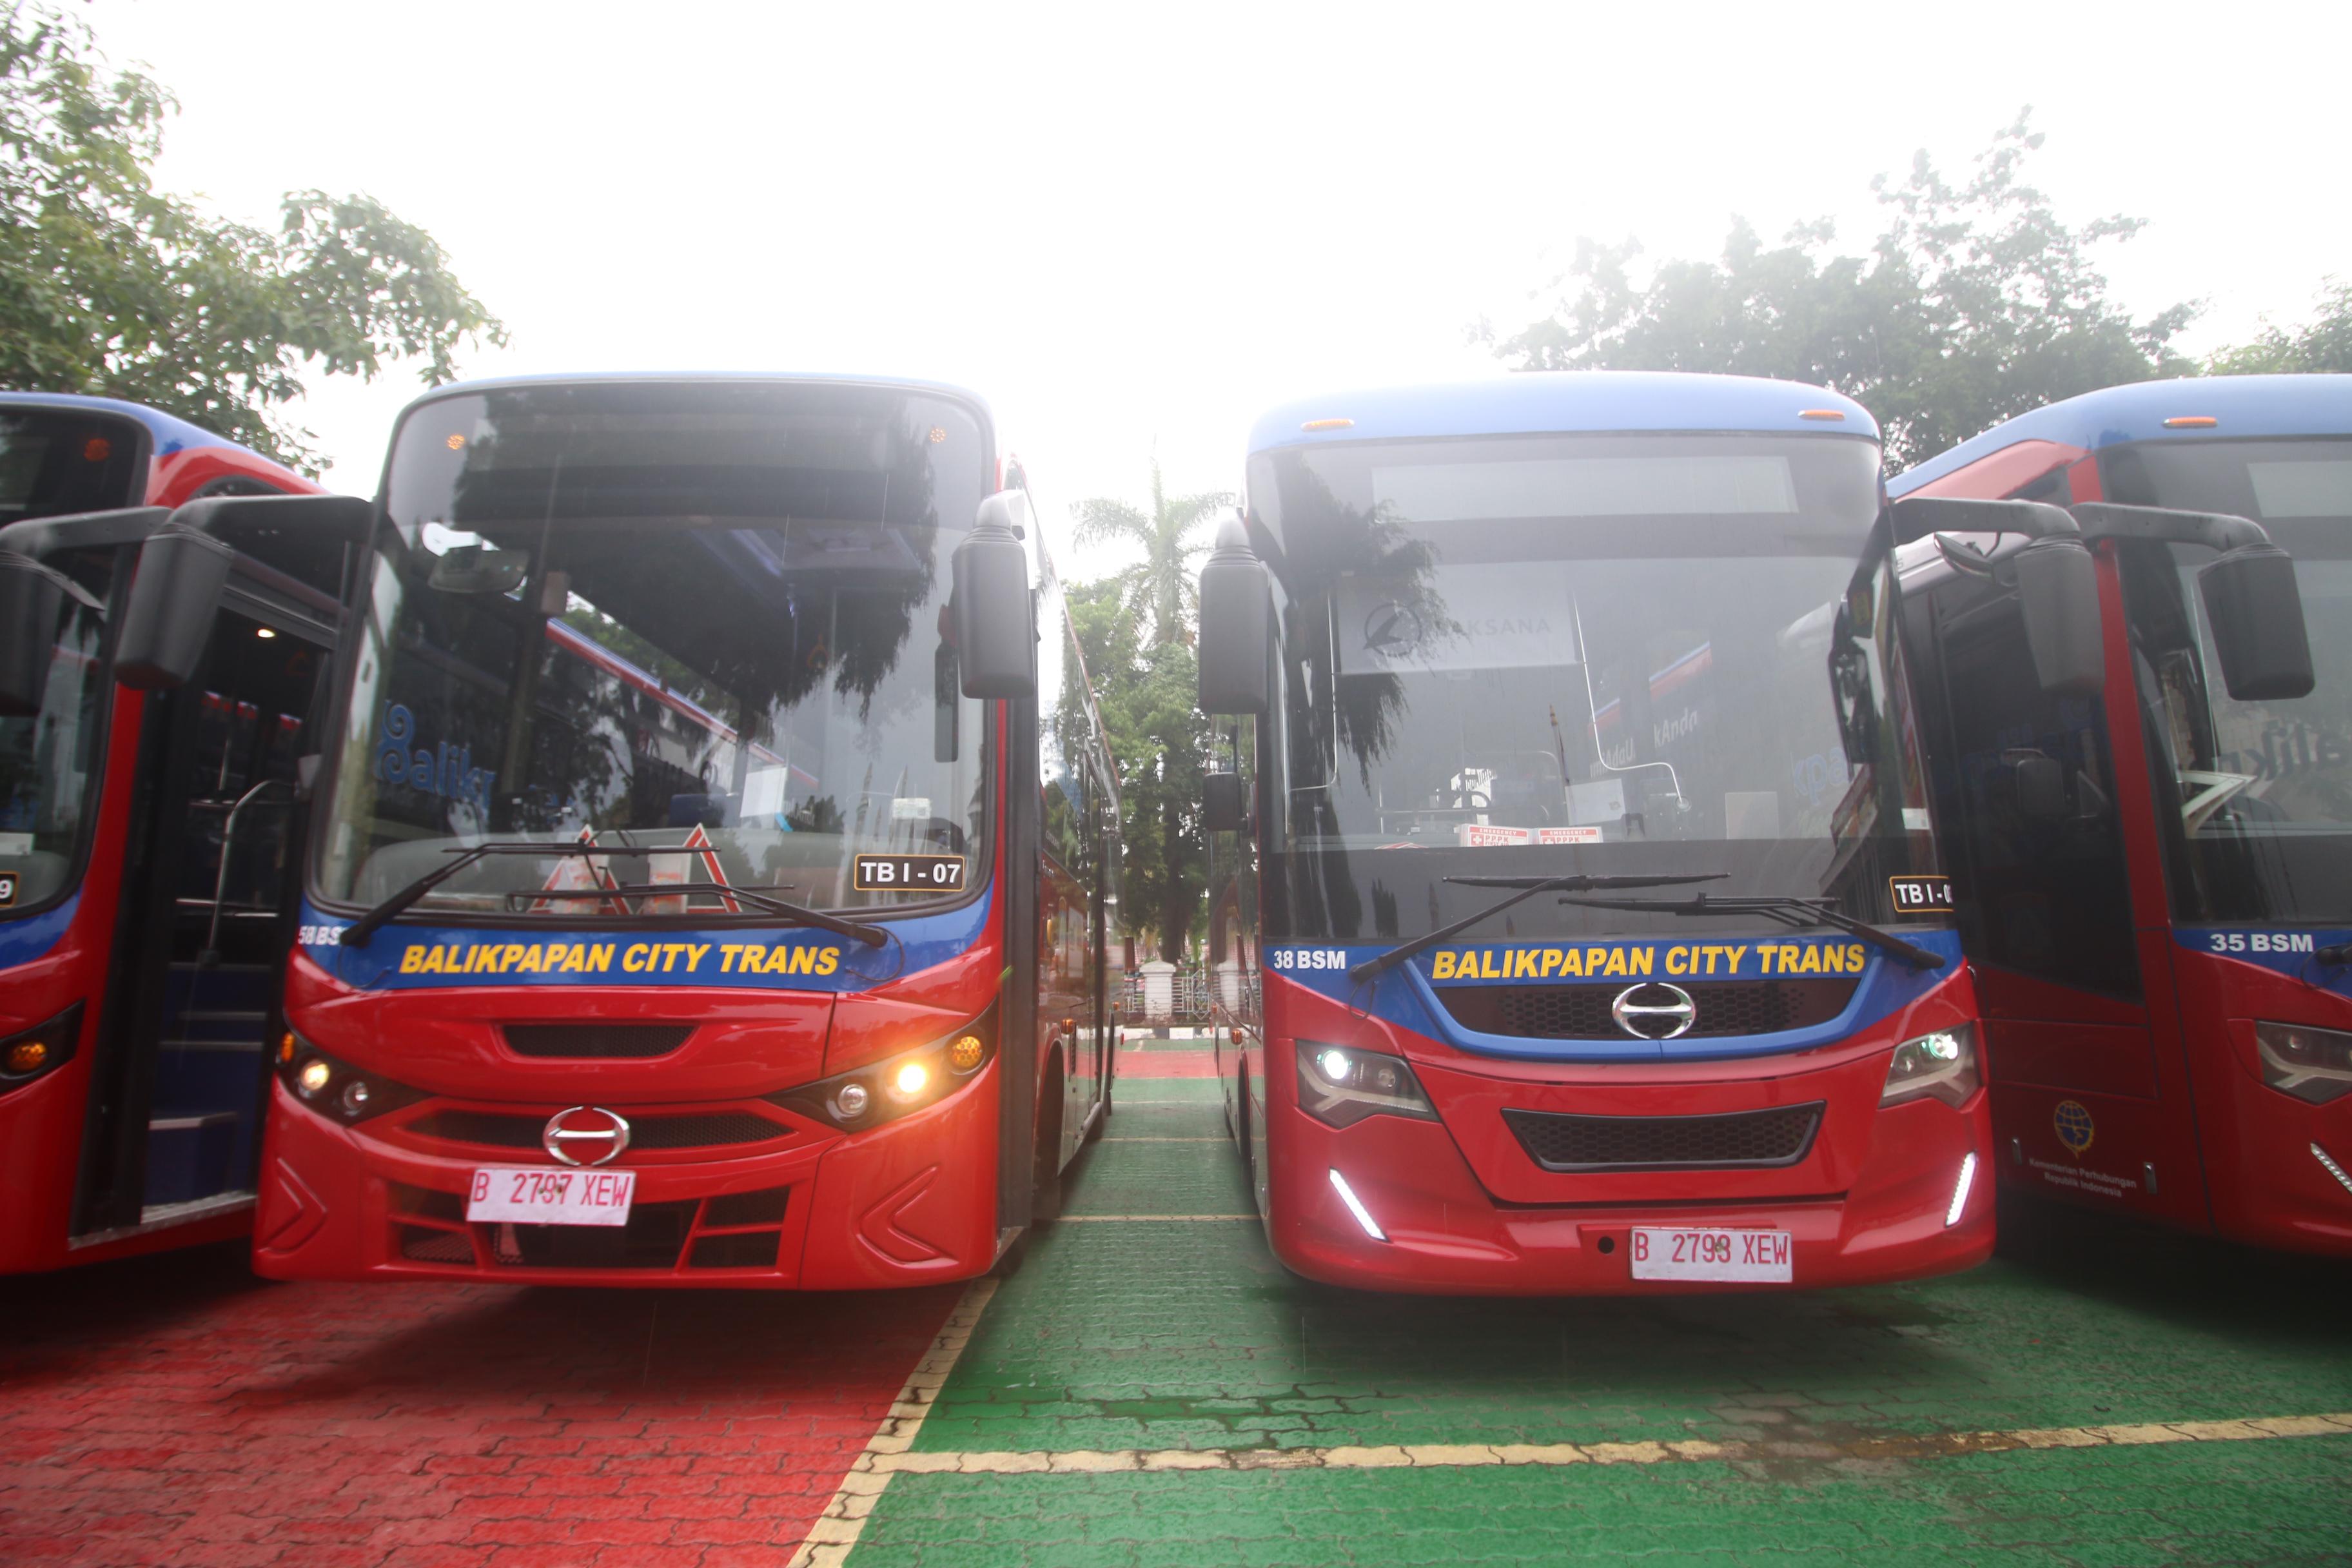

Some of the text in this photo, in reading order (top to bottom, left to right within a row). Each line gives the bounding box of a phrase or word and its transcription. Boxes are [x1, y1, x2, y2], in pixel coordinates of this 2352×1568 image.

[933, 863, 961, 883] 07
[315, 925, 349, 946] BS
[2210, 934, 2313, 952] 35 BSM
[399, 943, 840, 975] BALIKPAPAN CITY TRANS
[1273, 950, 1346, 969] 38 BSM
[1432, 944, 1865, 979] BALIKPAPAN CITY TRANS
[2029, 1158, 2137, 1189] Kementerian Perhubungan
[2044, 1172, 2122, 1198] Republik Indonesia
[474, 1173, 630, 1207] B 2797 XEW
[1634, 1232, 1649, 1261] B
[1743, 1235, 1788, 1264] XEW
